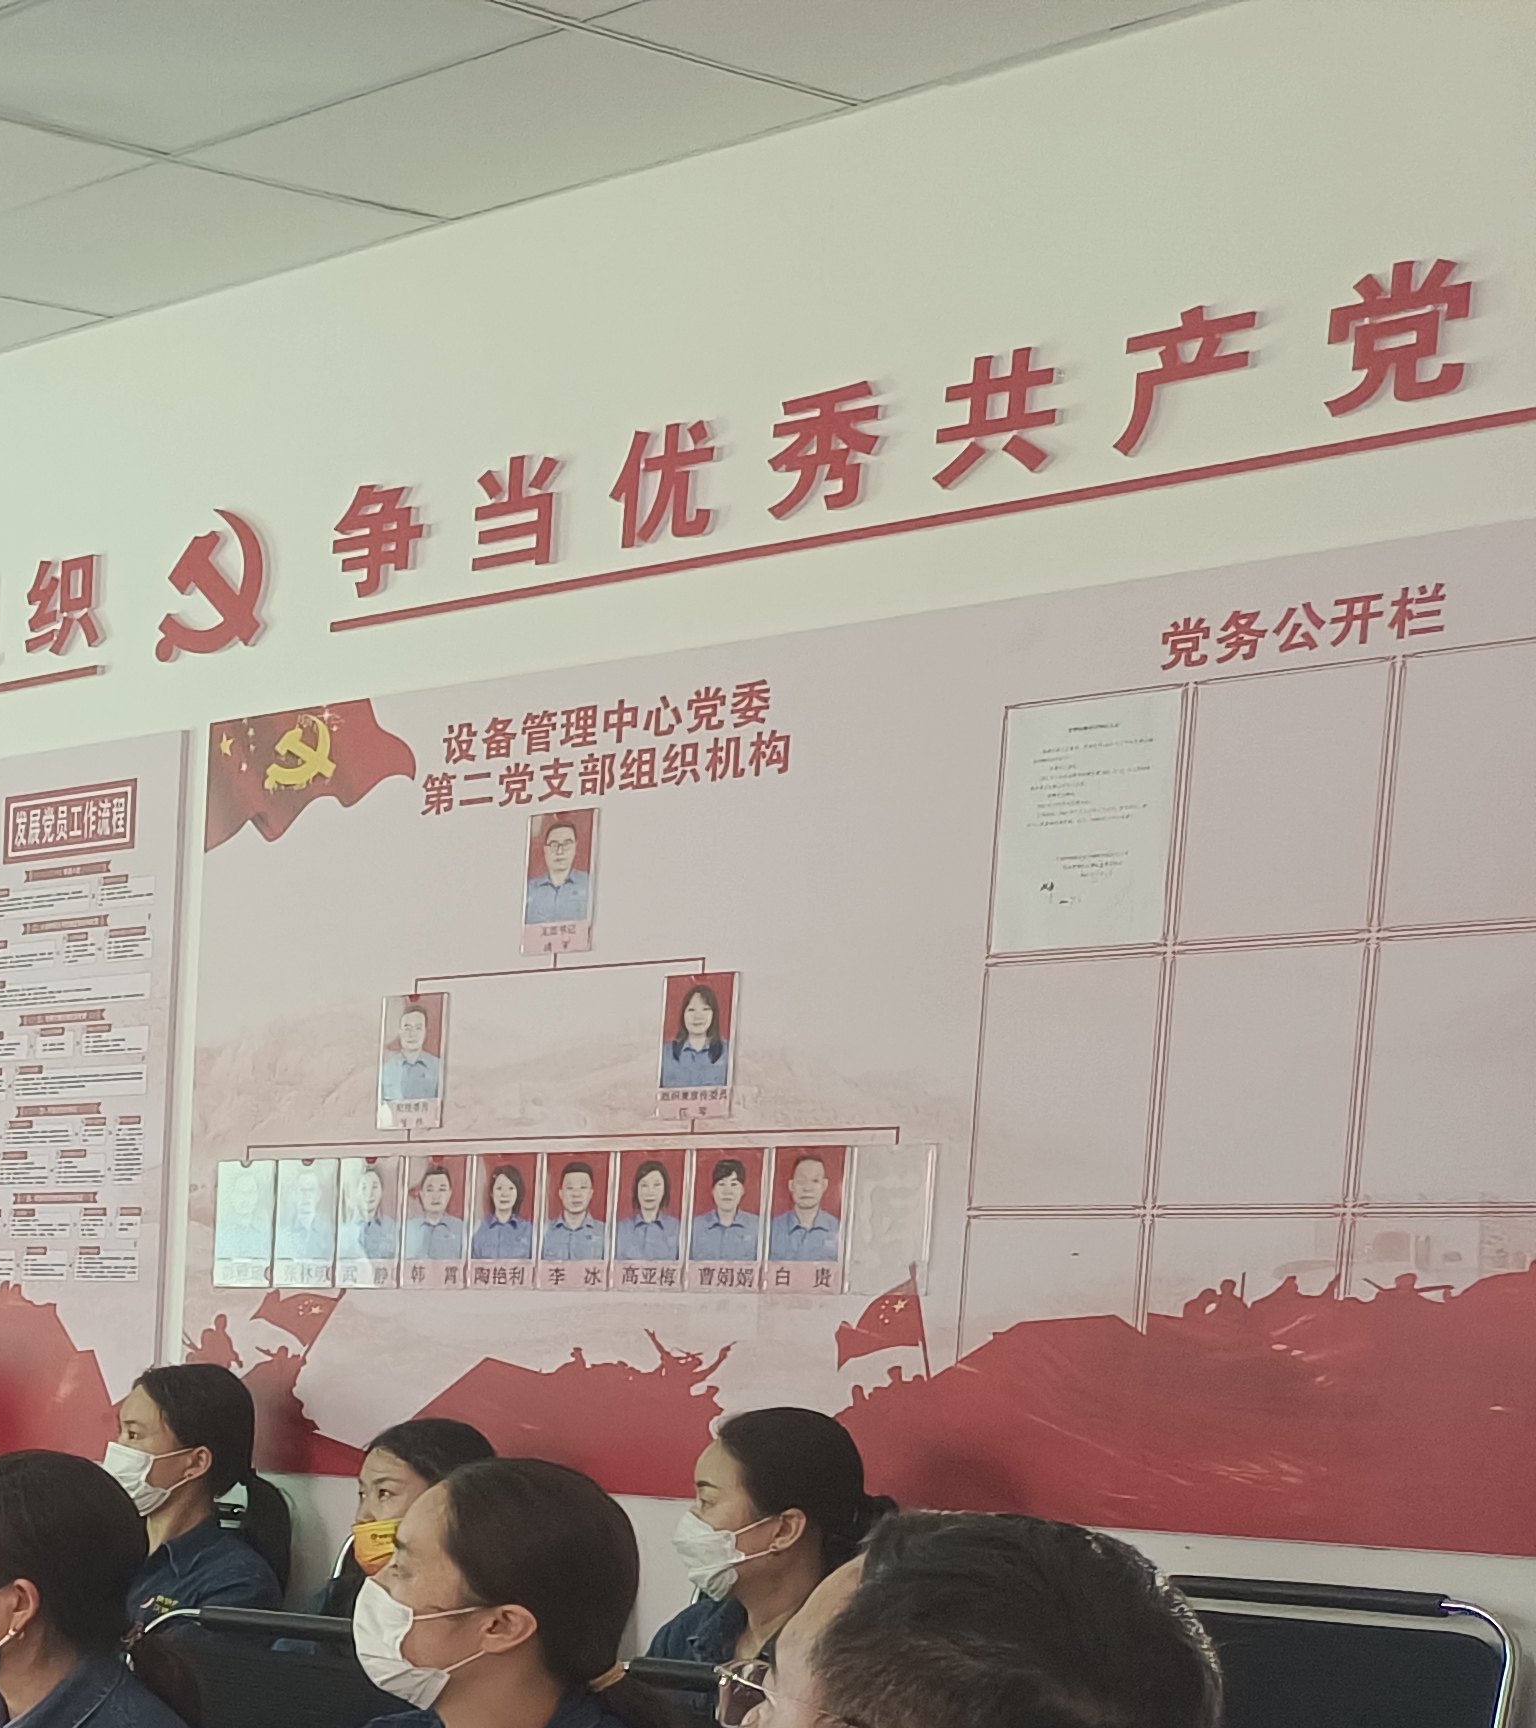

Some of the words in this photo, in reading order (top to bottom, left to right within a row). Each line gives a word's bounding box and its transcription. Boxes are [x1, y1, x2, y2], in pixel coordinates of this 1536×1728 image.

[330, 260, 1473, 597] 争当优秀共产党
[1160, 583, 1446, 671] 党务公开栏
[442, 679, 771, 766] 设备管理中心党委
[422, 730, 790, 816] 第二党支部组织机构
[15, 797, 126, 848] 发展党员工作流程
[474, 1266, 526, 1286] 陶艳利
[621, 1266, 678, 1286] 高亚梅
